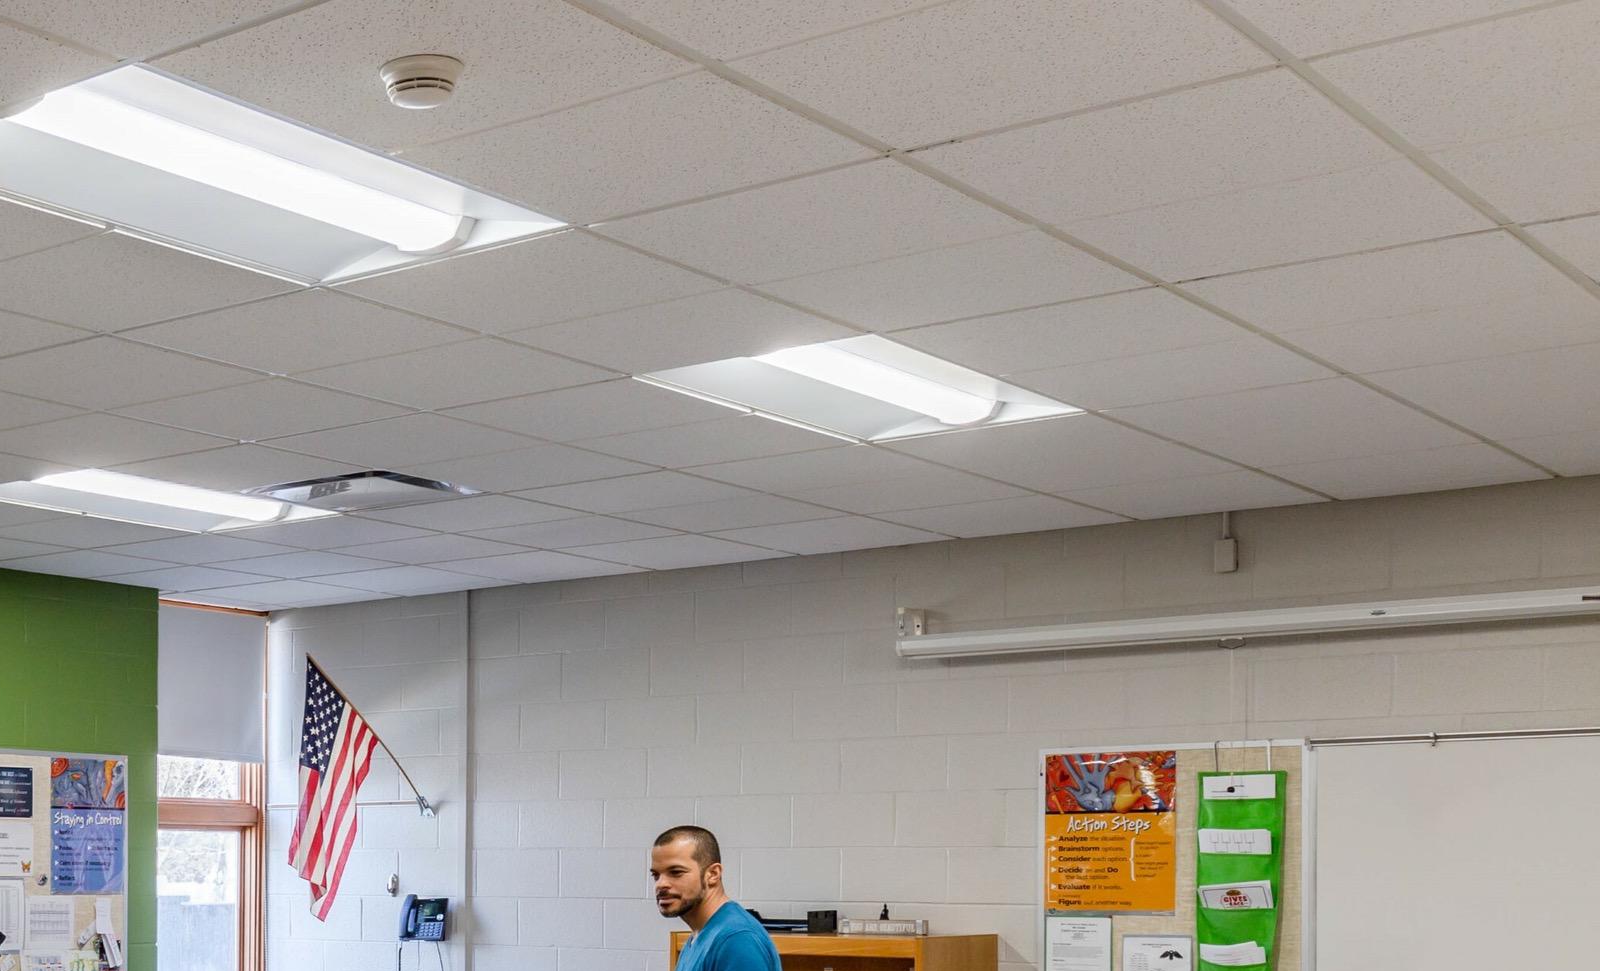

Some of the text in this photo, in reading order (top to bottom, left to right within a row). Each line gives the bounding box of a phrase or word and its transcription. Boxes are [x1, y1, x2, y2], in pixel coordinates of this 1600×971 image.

[53, 812, 123, 828] Staying in Control
[1066, 816, 1152, 835] Action Steps
